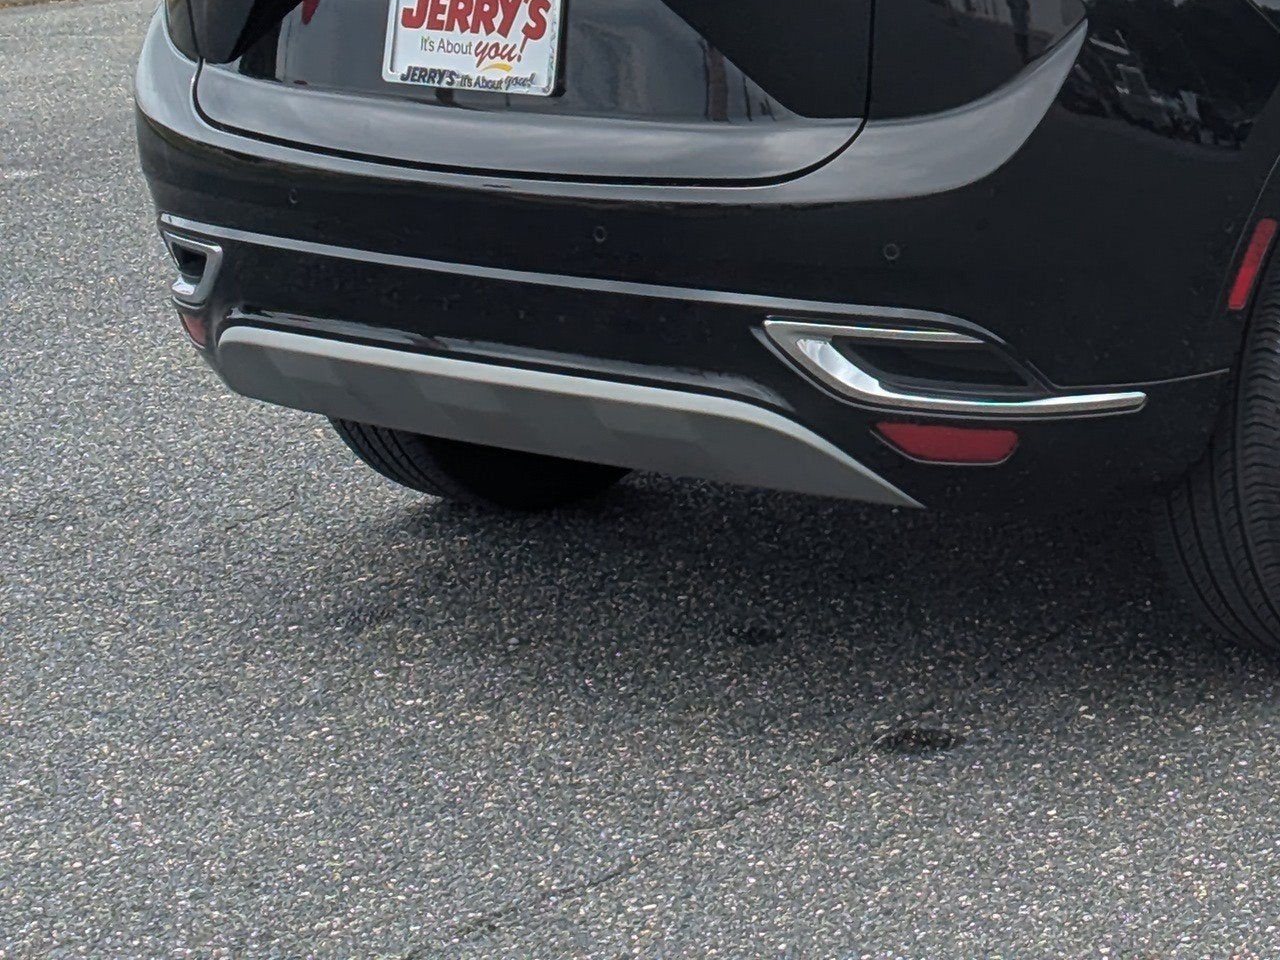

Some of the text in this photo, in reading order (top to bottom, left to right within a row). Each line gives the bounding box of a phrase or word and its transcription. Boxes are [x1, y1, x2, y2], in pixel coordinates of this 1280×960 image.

[420, 37, 529, 68] It's About you!
[400, 65, 458, 86] JERRY'S
[474, 75, 504, 90] About
